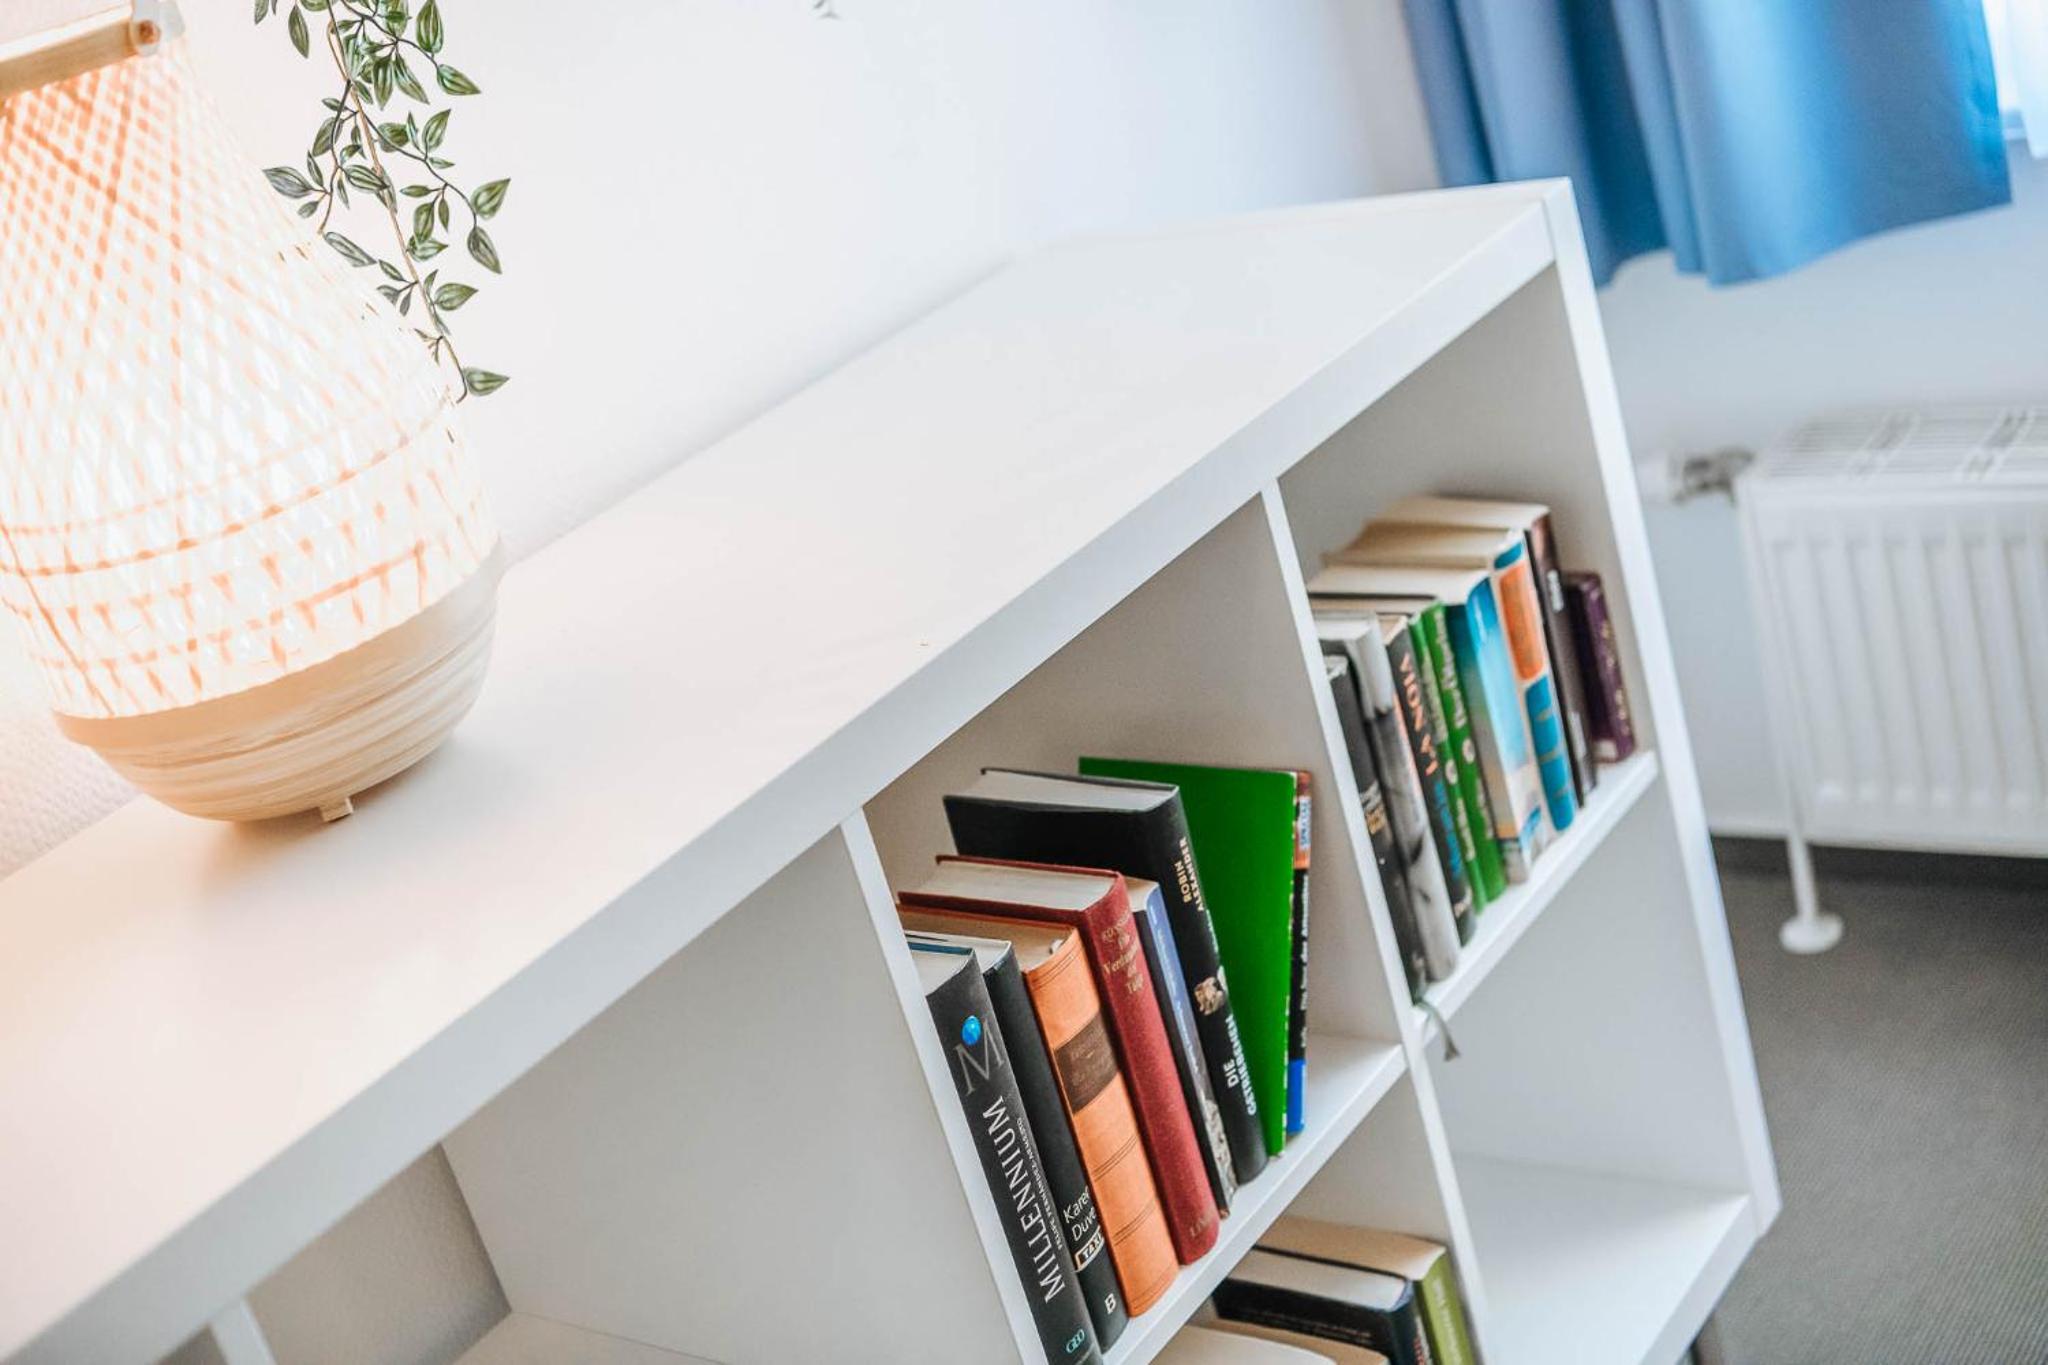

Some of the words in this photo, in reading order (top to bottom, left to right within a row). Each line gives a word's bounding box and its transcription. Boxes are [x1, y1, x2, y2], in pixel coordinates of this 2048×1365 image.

[1400, 652, 1424, 732] NOIA
[1174, 860, 1193, 904] ROBIN
[1179, 836, 1205, 912] ALEXANDER
[952, 1018, 1006, 1097] M
[1223, 1059, 1240, 1089] DIE
[1225, 1013, 1257, 1116] GETRIEBENEN
[982, 1095, 1066, 1304] MILLENNIUM
[1049, 1219, 1063, 1251] FELIPE
[1066, 1328, 1085, 1354] GEO
